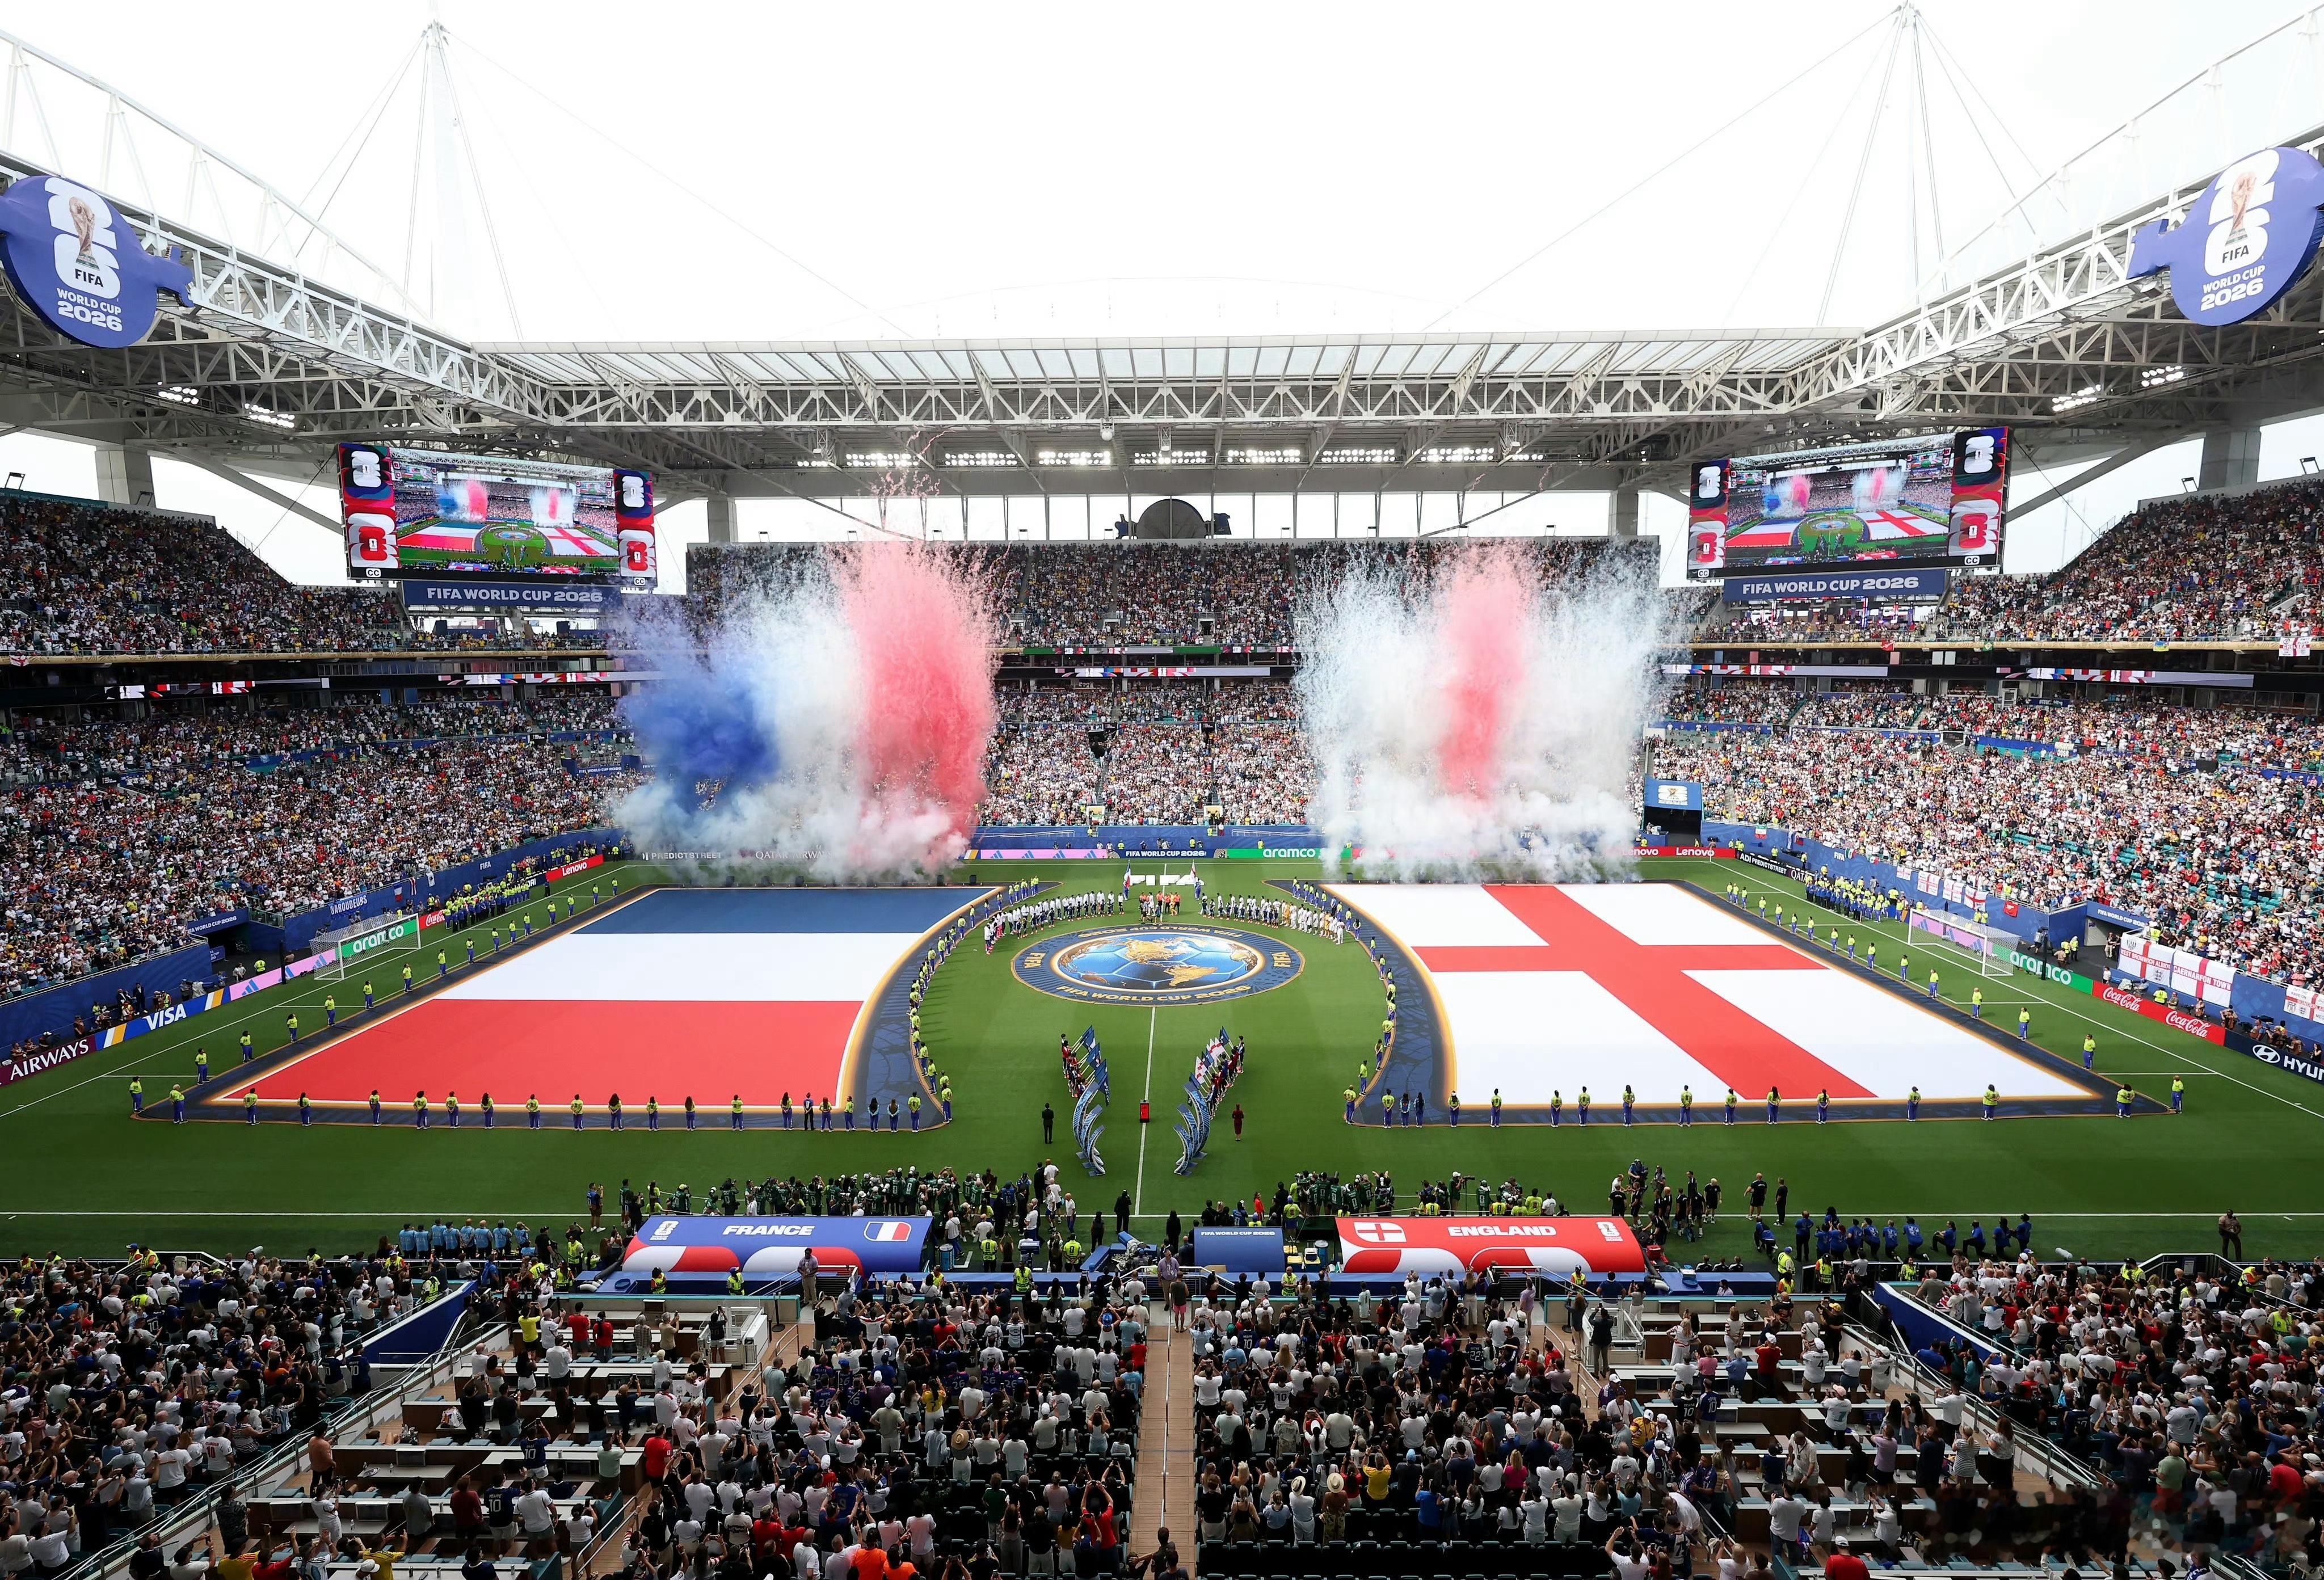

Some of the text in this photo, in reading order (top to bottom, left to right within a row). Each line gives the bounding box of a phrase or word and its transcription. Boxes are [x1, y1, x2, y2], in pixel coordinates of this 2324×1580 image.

[2222, 245, 2249, 263] FIFA
[75, 268, 103, 287] FIFA
[2203, 265, 2266, 292] WORLD CUP
[2200, 277, 2264, 311] 2026
[57, 288, 121, 315] WORLD CUP
[58, 301, 123, 331] 2026
[1742, 576, 1919, 595] FIFA WORLD CUP 2026
[428, 587, 603, 602] FIFA WORLD CUP 2026
[1263, 848, 1316, 858] aramco
[1675, 848, 1715, 856] Lenovo
[1834, 852, 1845, 861] FIFA
[480, 861, 491, 870] FIFA
[562, 861, 587, 877] Lenovo
[1752, 857, 1787, 874] PREDICTSTREET
[1126, 875, 1205, 886] FIFA
[1791, 870, 1808, 883] QATA
[330, 895, 368, 915] BAROUDEURS
[2108, 912, 2123, 921] WORLD
[353, 924, 404, 953] aramco
[1024, 953, 1046, 969] FIFA
[1272, 951, 1291, 968] FIFA
[2132, 952, 2155, 965] BROMWICH
[2173, 966, 2231, 990] CAERNARFON TOWN
[1058, 985, 1088, 997] FIFA
[1091, 993, 1153, 1001] WORLD
[1195, 985, 1251, 999] 2026
[2103, 987, 2143, 1012] Coca-Cola
[142, 1004, 187, 1030] VISA
[2165, 1010, 2211, 1038] Coca-Cola
[10, 1039, 89, 1080] AIRWAYS
[722, 1225, 815, 1236] FRANCE
[1447, 1225, 1557, 1237] ENGLAND
[149, 1321, 161, 1332] 10
[1244, 1339, 1253, 1350] 10
[350, 1366, 359, 1376] 10
[1817, 1360, 1824, 1370] 4
[1884, 1366, 1890, 1376] 4
[952, 1380, 965, 1389] 26
[1277, 1393, 1286, 1401] 10
[1258, 1404, 1265, 1412] 7
[1683, 1408, 1694, 1417] 10
[1708, 1402, 1717, 1413] 10
[2188, 1419, 2195, 1430] 7
[207, 1447, 216, 1459] 10
[524, 1448, 536, 1460] 10
[489, 1499, 501, 1512] 10
